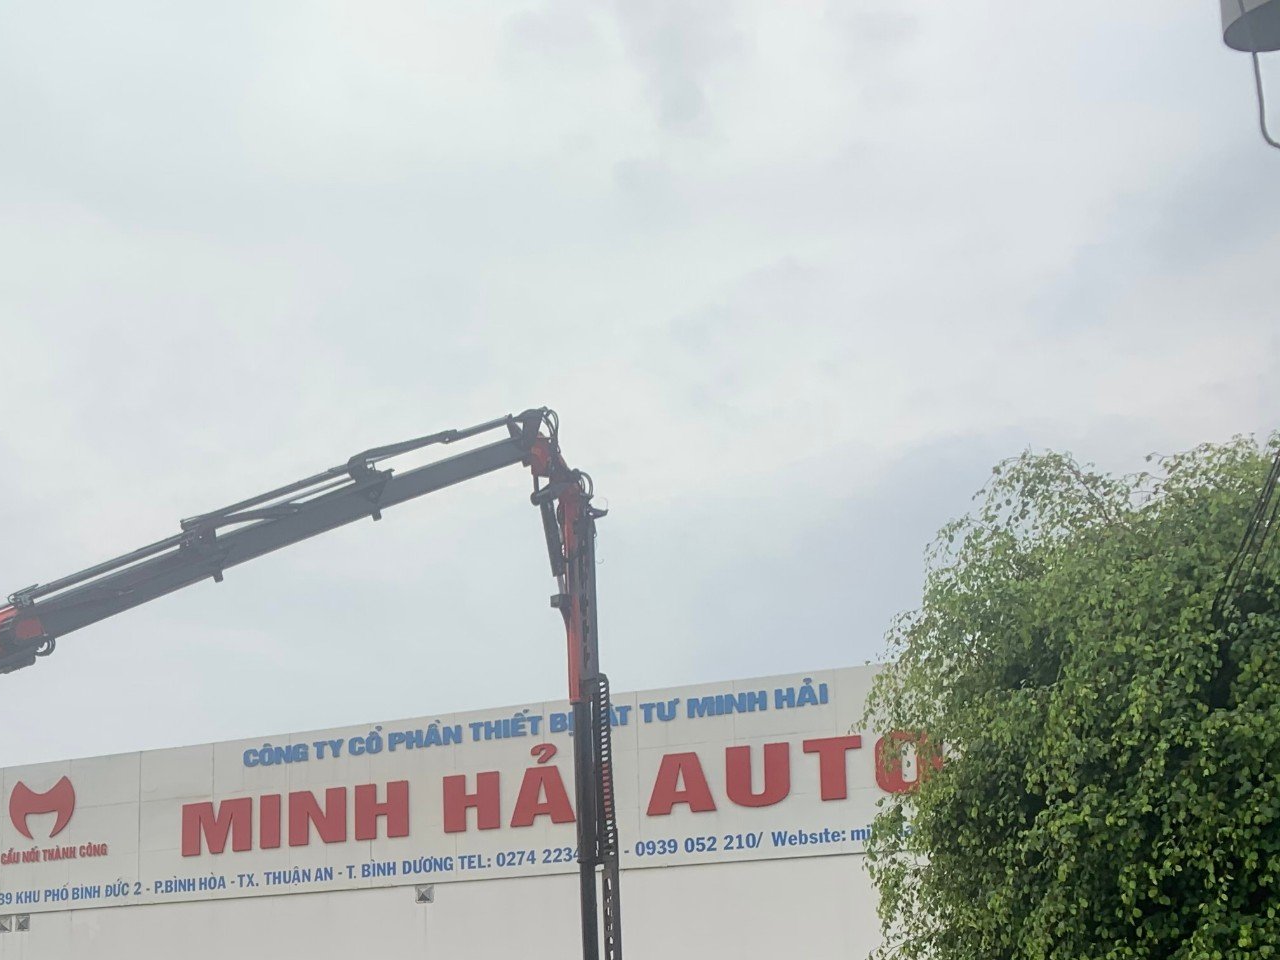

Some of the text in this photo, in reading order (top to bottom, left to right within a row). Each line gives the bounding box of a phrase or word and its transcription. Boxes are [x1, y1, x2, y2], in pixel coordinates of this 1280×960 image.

[243, 743, 309, 767] CÔNG
[313, 739, 344, 759] TY
[348, 726, 383, 756] CỔ
[388, 720, 462, 751] PHẦN
[469, 709, 542, 741] THIẾT
[639, 698, 679, 723] TƯ
[687, 690, 767, 718] MINH
[774, 677, 829, 709] HẢI
[181, 780, 410, 857] MINH
[646, 730, 942, 816] AUTO
[16, 890, 40, 904] KHU
[44, 882, 69, 902] PHỐ
[72, 884, 100, 900] BÌNH
[105, 877, 129, 897] ĐỨC
[133, 882, 141, 895] 2
[154, 876, 196, 894] P.BÌNH
[199, 872, 226, 891] HÒA
[264, 866, 311, 887] THUẬN
[314, 867, 333, 882] AN
[346, 865, 356, 879] T.
[361, 859, 397, 878] BÌNH
[402, 856, 454, 875] DƯƠNG
[458, 854, 491, 870] TEL:
[496, 850, 536, 867] 0274
[635, 838, 678, 857] 0939
[684, 836, 717, 853] 052
[723, 831, 763, 850] 210/
[771, 829, 846, 847] Website:
[42, 845, 77, 862] THÀNH
